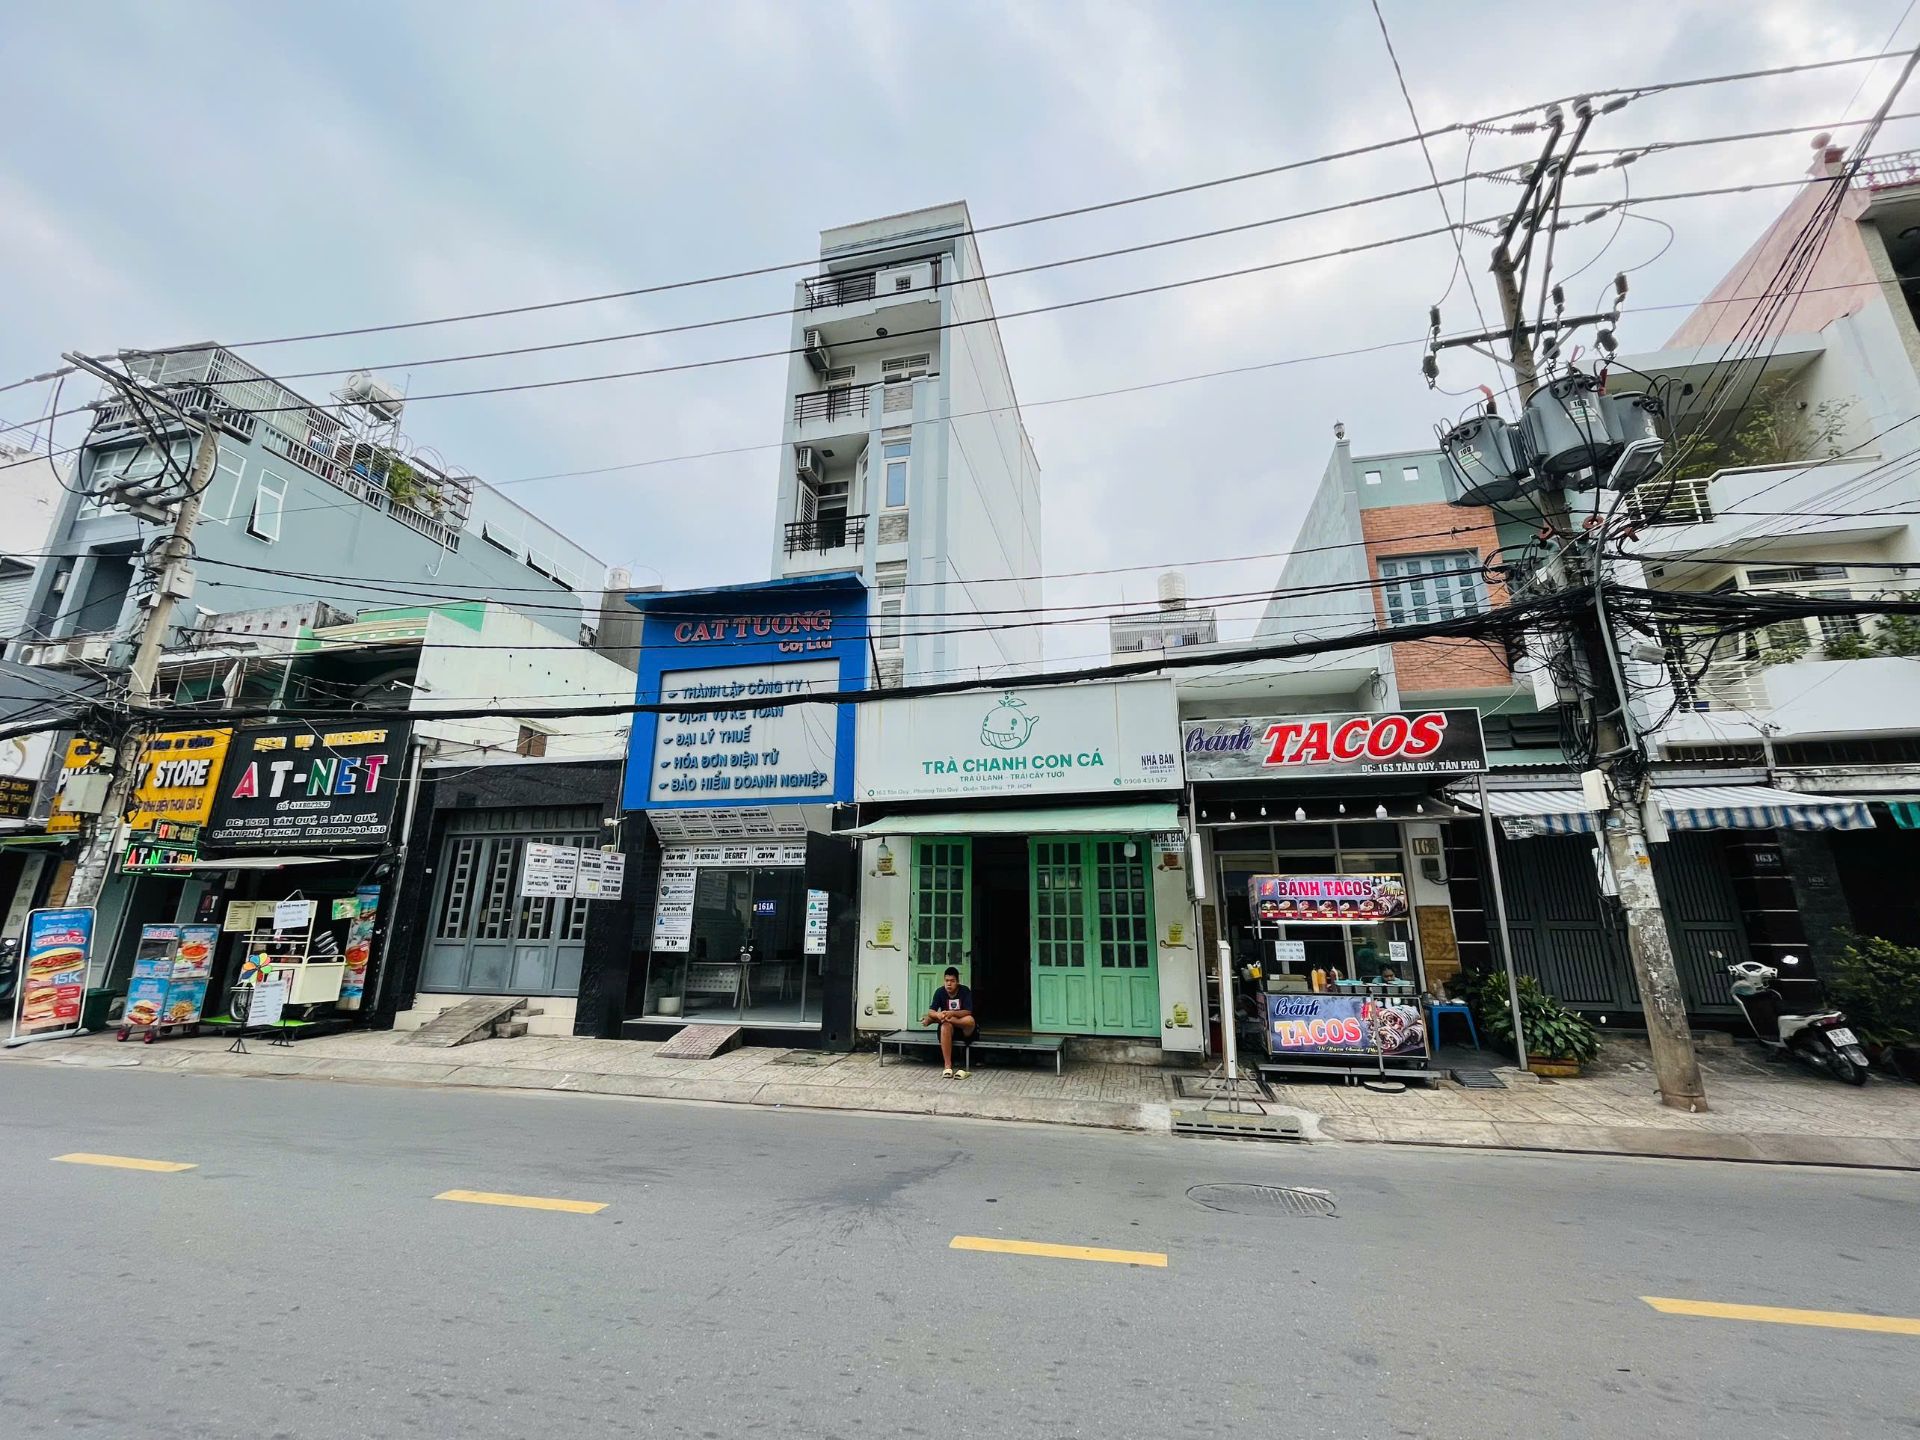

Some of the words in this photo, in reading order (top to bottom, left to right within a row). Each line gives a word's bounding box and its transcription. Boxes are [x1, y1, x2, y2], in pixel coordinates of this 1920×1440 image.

[683, 683, 721, 699] THÀNH
[722, 681, 745, 698] LẬP
[748, 679, 783, 695] CÔNG
[676, 731, 697, 747] ĐẠI
[700, 728, 716, 744] LÝ
[719, 724, 753, 744] THUẾ
[1260, 711, 1448, 767] TACOS
[673, 752, 699, 769] HÓA
[701, 754, 728, 768] ĐƠN
[730, 751, 758, 769] ĐIỆN
[761, 748, 780, 765] TỬ
[922, 755, 959, 775] TRÀ
[962, 756, 1027, 774] CHANH
[1032, 753, 1072, 769] CON
[1077, 748, 1104, 767] CÁ
[1378, 763, 1394, 772] 163
[1395, 761, 1417, 772] TÂN
[1417, 760, 1438, 772] QUÝ,
[1438, 759, 1460, 770] TÂN
[153, 758, 211, 788] STORE
[232, 754, 389, 798] AT-NET
[671, 774, 697, 792] BẢO
[700, 770, 731, 791] HIỂM
[734, 774, 778, 789] DOANH
[780, 770, 828, 788] NGHIỆP
[273, 816, 294, 826] TÂN
[330, 813, 352, 824] TÂN
[264, 828, 301, 837] TP.HCM
[1277, 878, 1321, 897] BÁNH
[1323, 878, 1374, 897] TACOS
[758, 902, 774, 911] 161A
[53, 972, 81, 986] 15K
[1275, 996, 1320, 1017] Bánh
[1274, 1017, 1363, 1047] TACOS
